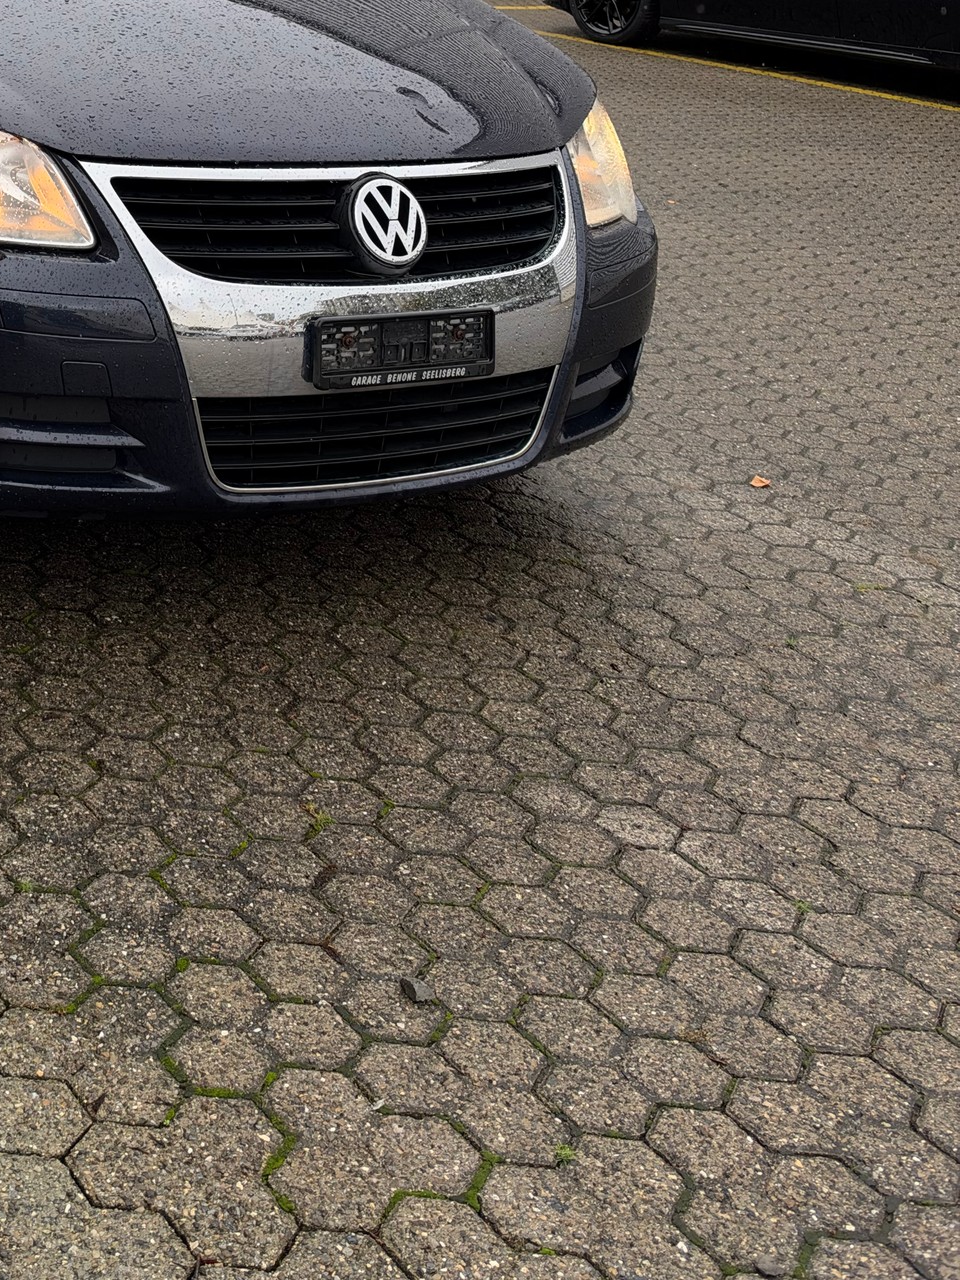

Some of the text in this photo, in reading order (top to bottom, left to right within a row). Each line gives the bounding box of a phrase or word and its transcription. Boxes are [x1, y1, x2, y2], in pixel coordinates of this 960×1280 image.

[355, 178, 427, 263] VW
[351, 367, 466, 386] GARAGE BENONE SEELISBERG
